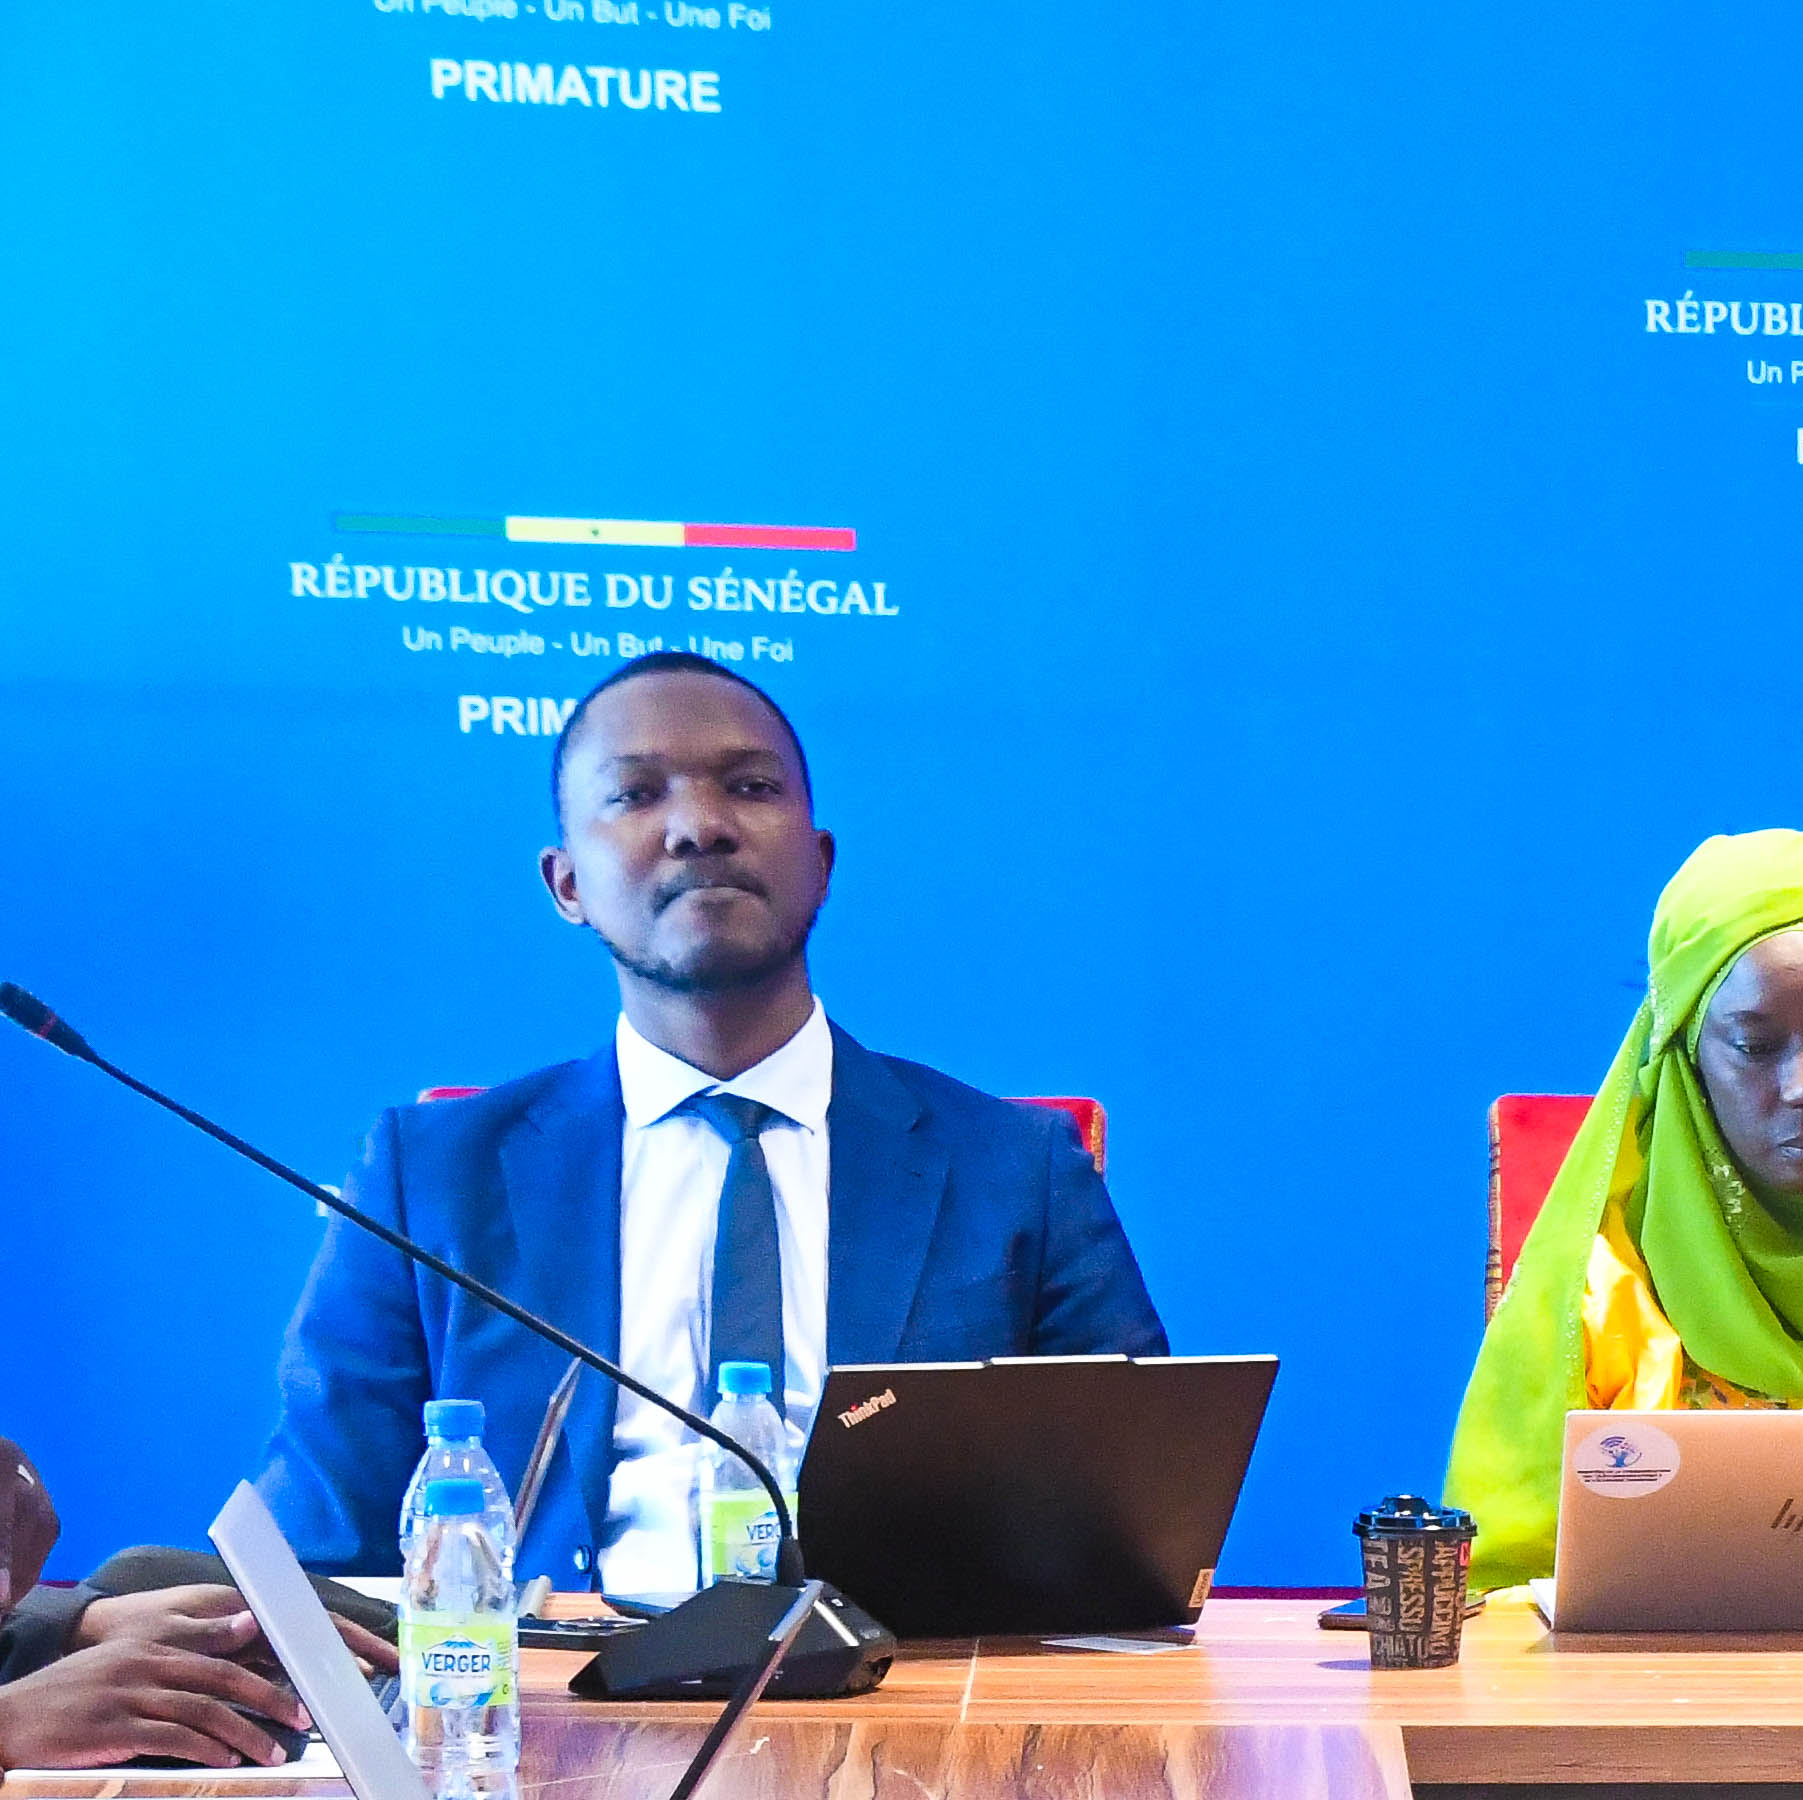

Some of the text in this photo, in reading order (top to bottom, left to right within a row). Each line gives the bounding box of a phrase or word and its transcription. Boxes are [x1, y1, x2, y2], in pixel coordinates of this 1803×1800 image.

[544, 0, 584, 21] Un
[592, 0, 638, 24] But
[665, 2, 720, 28] Une
[728, 3, 772, 31] Foi
[432, 59, 721, 112] PRIMATURE
[1748, 361, 1782, 384] Un
[291, 554, 898, 615] RÉPUBLIQUE DU SÉNÉGAL
[403, 627, 442, 651] Un
[450, 627, 544, 658] Peuple
[571, 632, 610, 656] Un
[618, 633, 662, 658] But
[690, 636, 744, 660] Une
[752, 637, 792, 662] Foi
[458, 695, 577, 735] PRIM
[421, 1651, 491, 1673] VERGER
